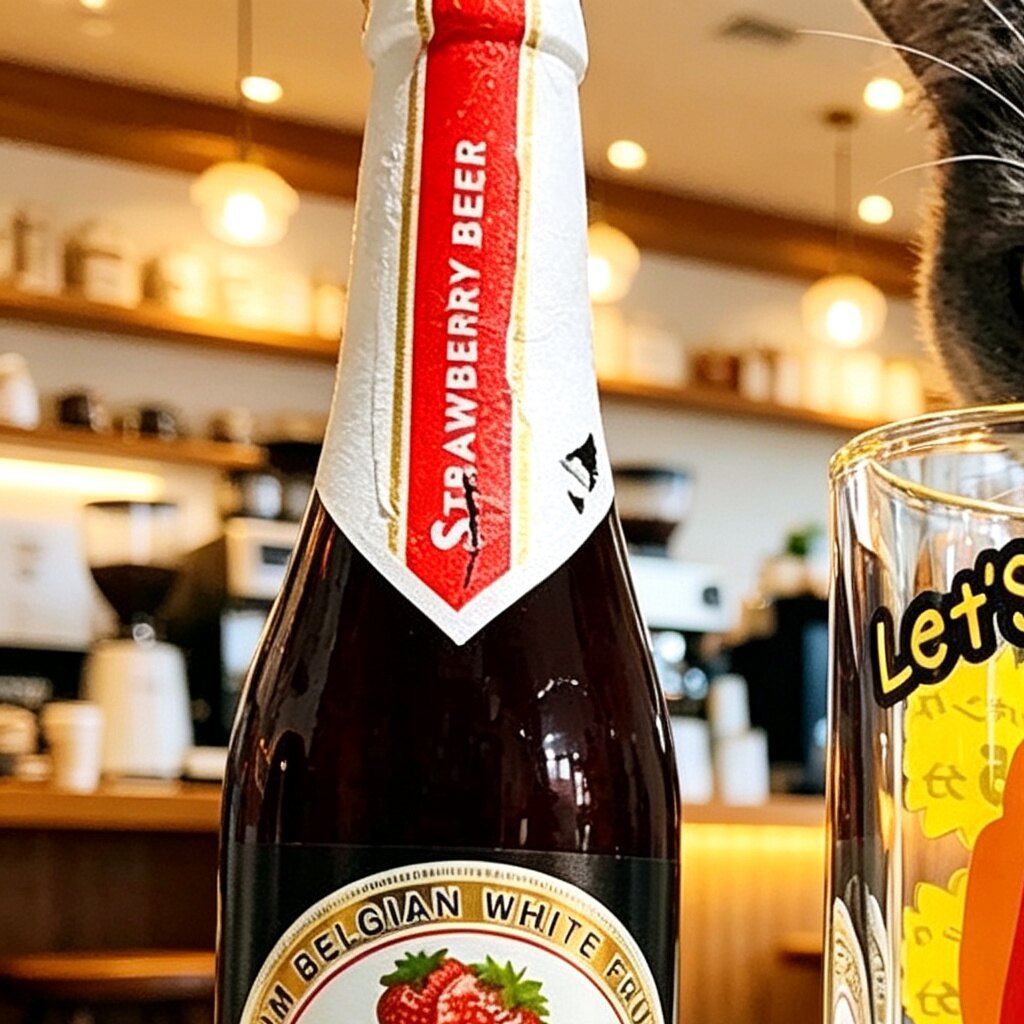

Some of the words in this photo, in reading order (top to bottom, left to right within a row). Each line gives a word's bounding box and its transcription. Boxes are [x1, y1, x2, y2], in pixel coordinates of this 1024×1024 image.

[452, 138, 487, 250] BEER
[293, 886, 461, 982] BELGIAN
[486, 889, 601, 960] WHITE
